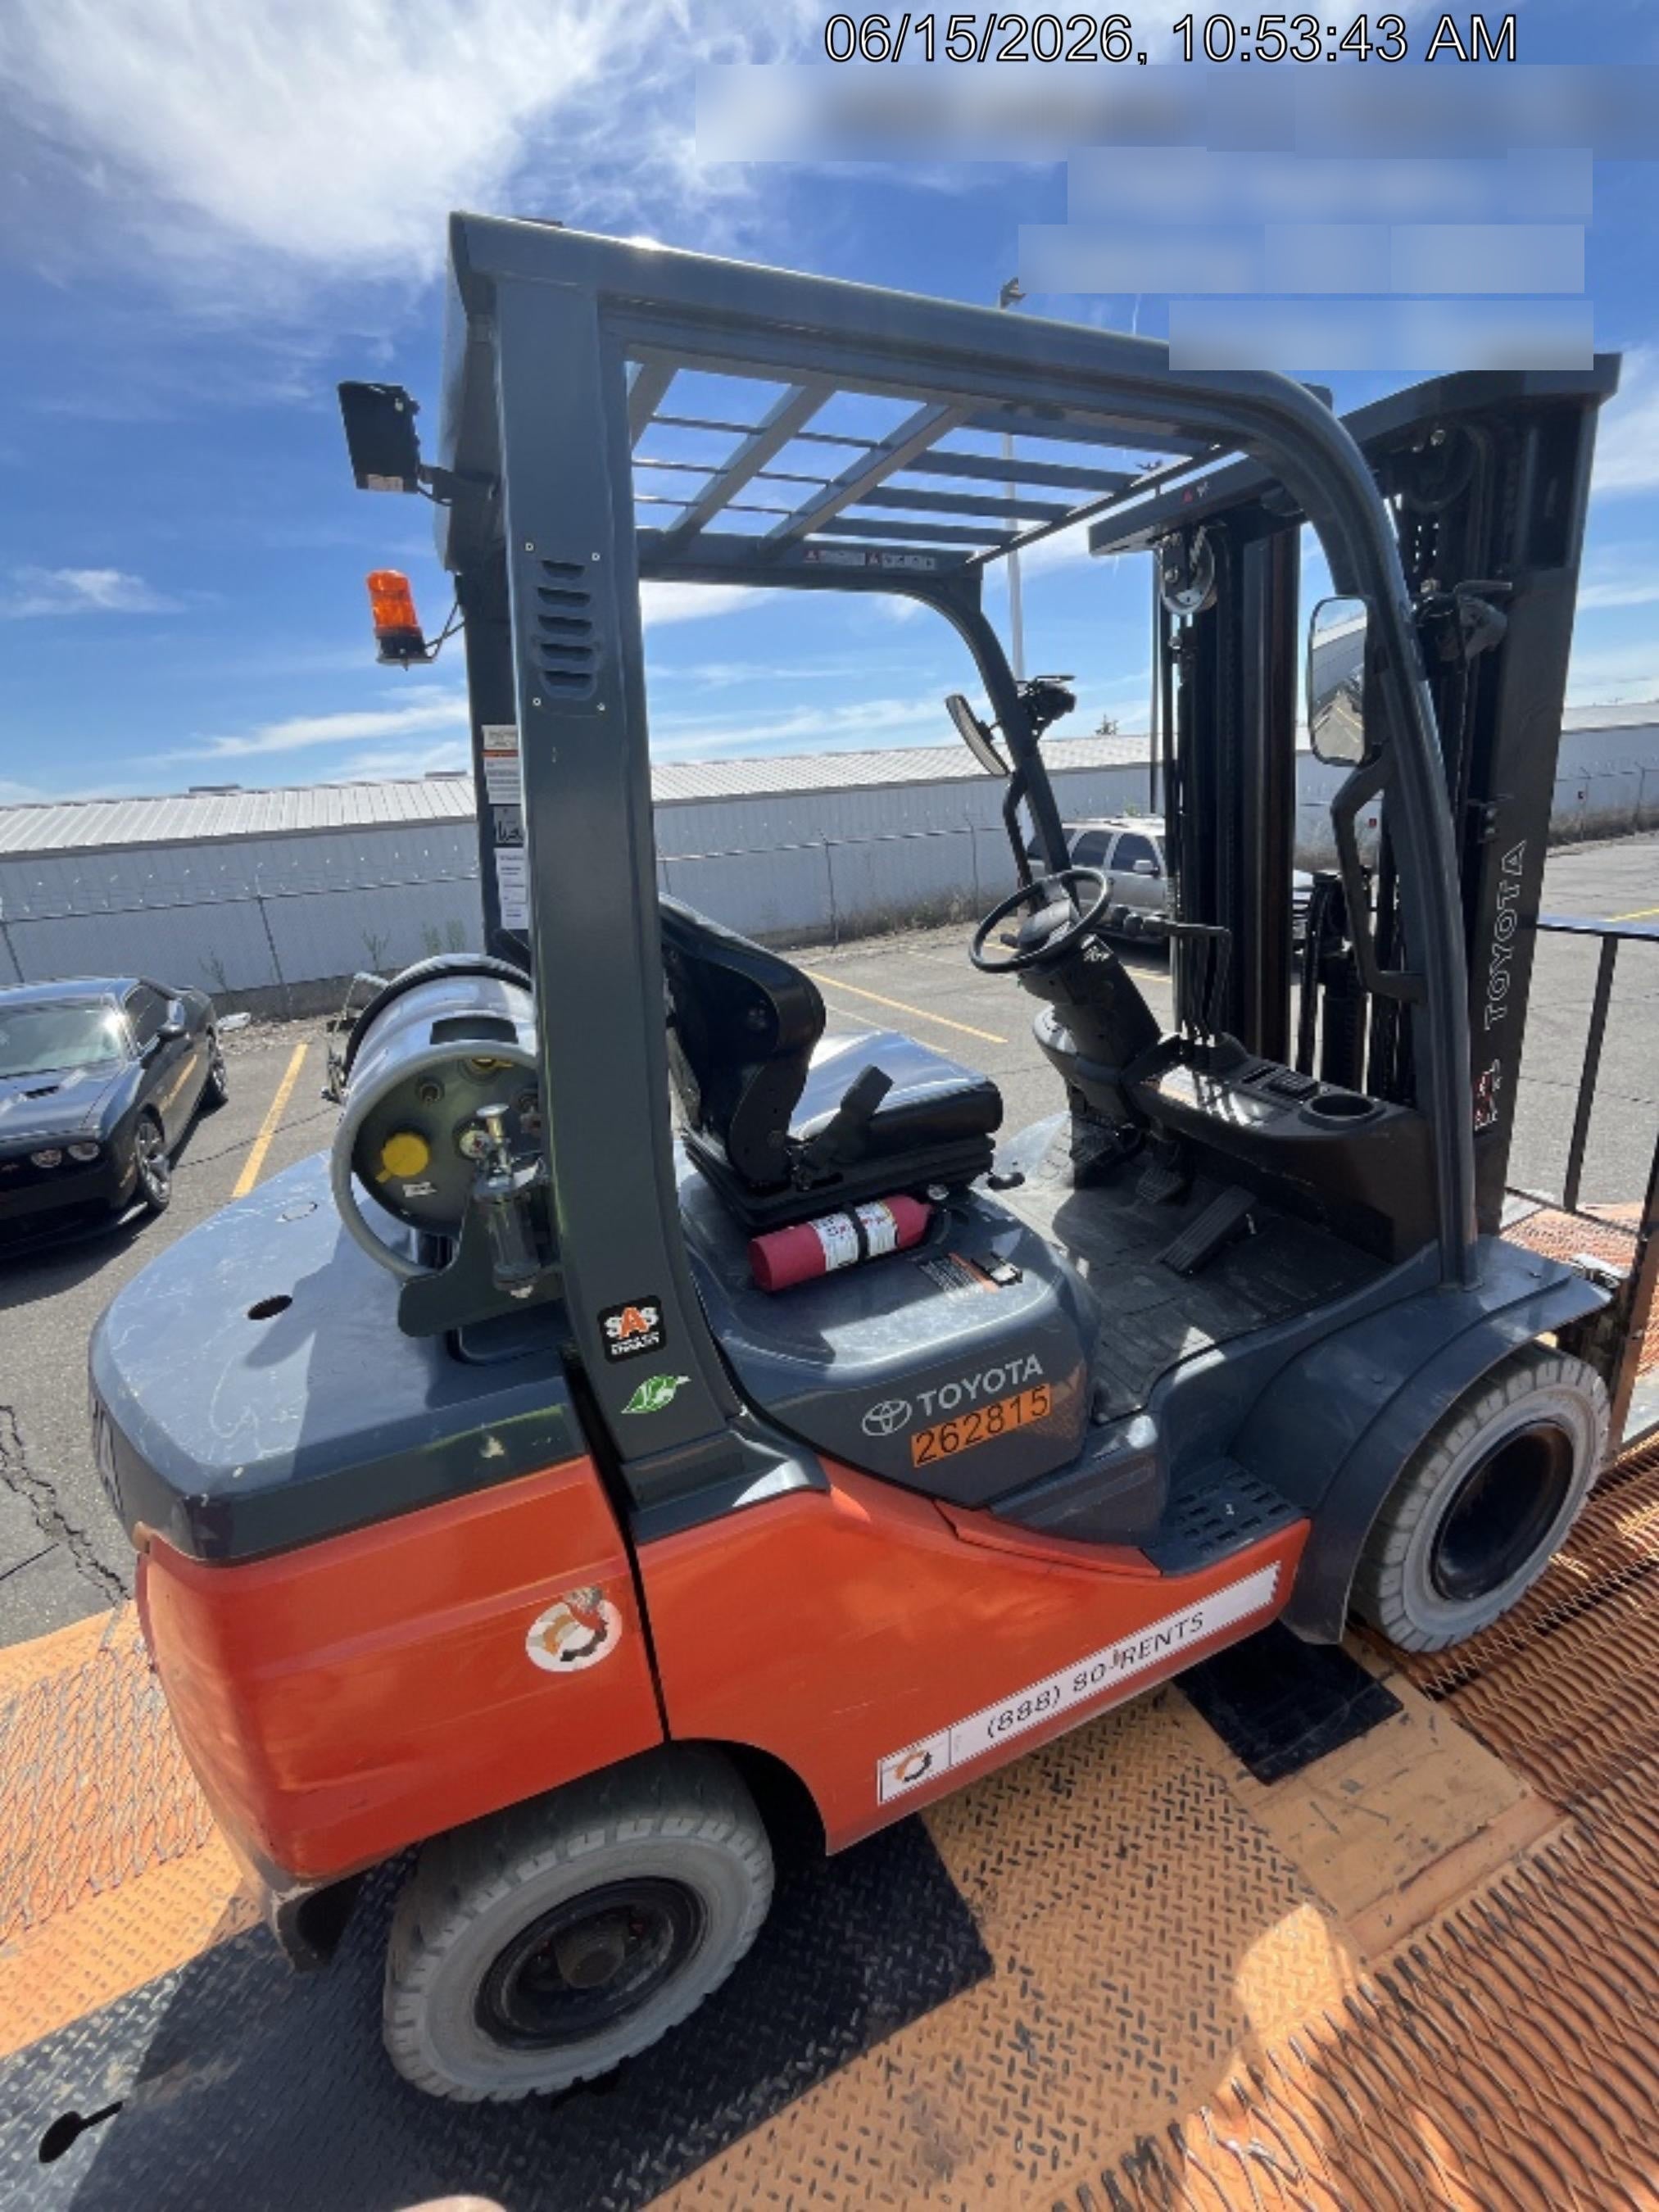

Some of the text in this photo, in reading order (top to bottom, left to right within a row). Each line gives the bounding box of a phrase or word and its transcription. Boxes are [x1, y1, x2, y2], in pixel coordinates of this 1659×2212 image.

[1484, 839, 1526, 1031] TOYOTA
[605, 1305, 659, 1339] SAS
[917, 1353, 1044, 1416] TOYOTA
[915, 1385, 1049, 1465] 262815
[986, 1685, 1061, 1738] (888)
